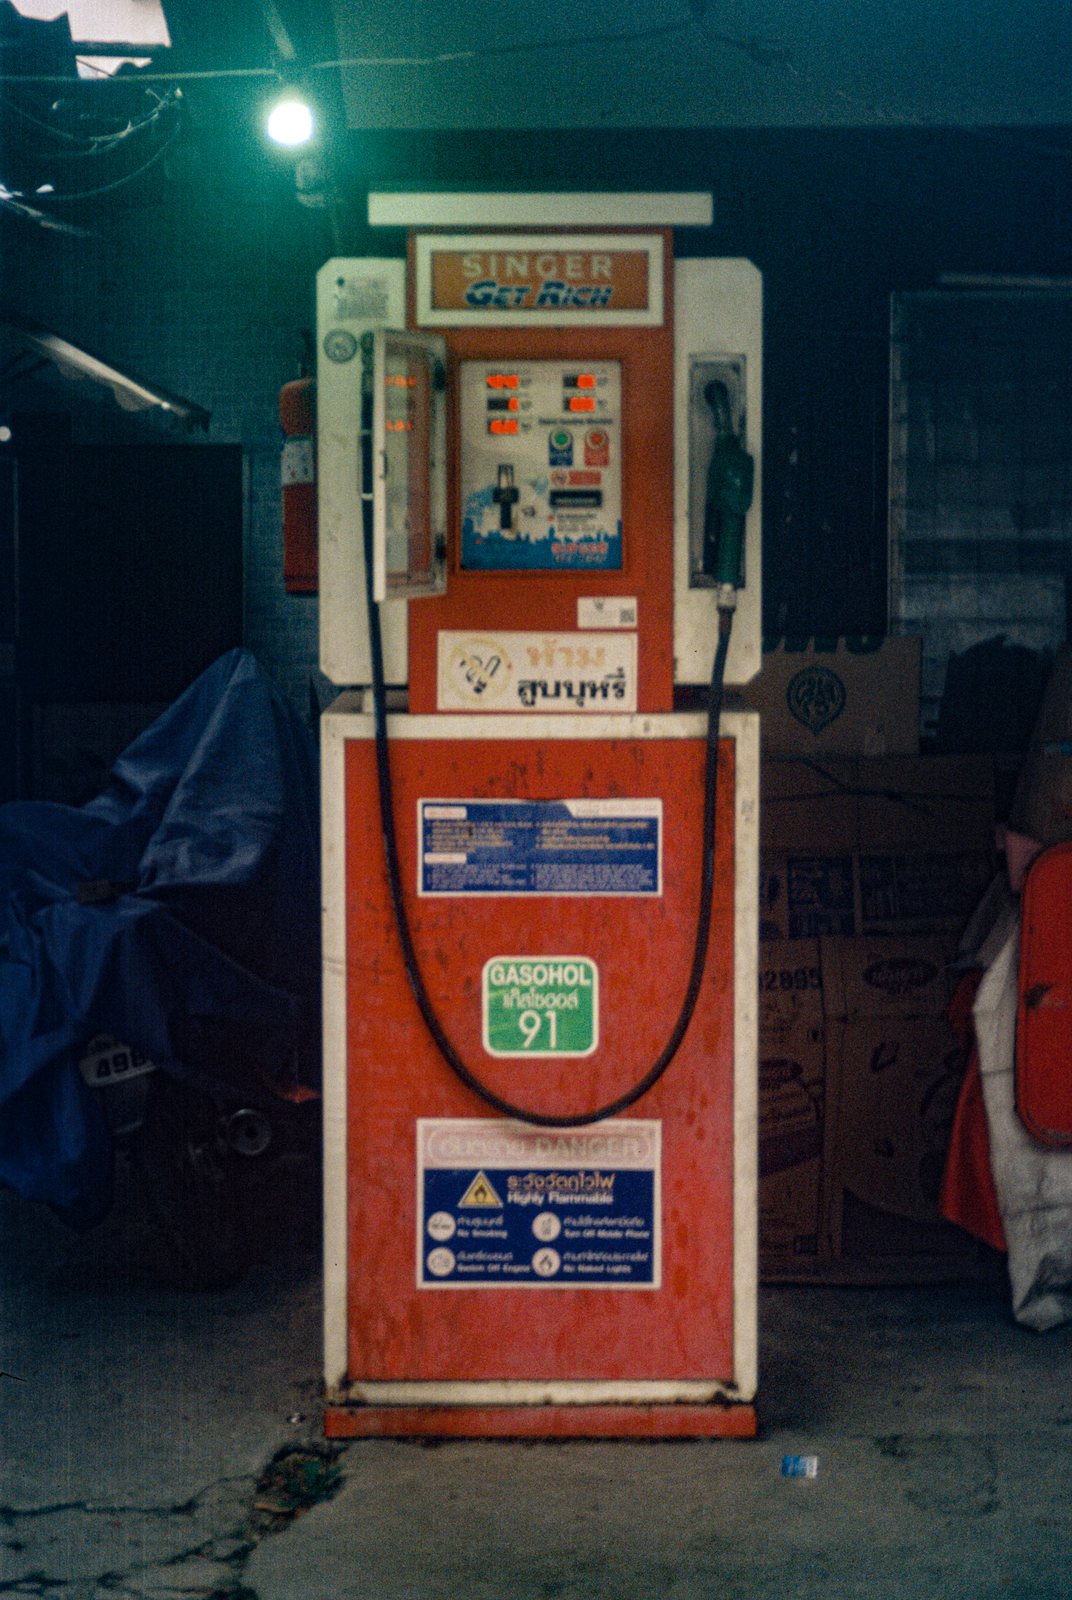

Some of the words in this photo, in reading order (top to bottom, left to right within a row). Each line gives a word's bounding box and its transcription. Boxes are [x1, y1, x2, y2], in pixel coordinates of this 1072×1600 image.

[462, 254, 613, 278] SINGER
[517, 666, 626, 707] สูบบุหรี่
[490, 964, 592, 986] GASOHOL
[518, 1009, 557, 1049] 91
[507, 1191, 545, 1206] Highly
[548, 1191, 614, 1204] Flammable
